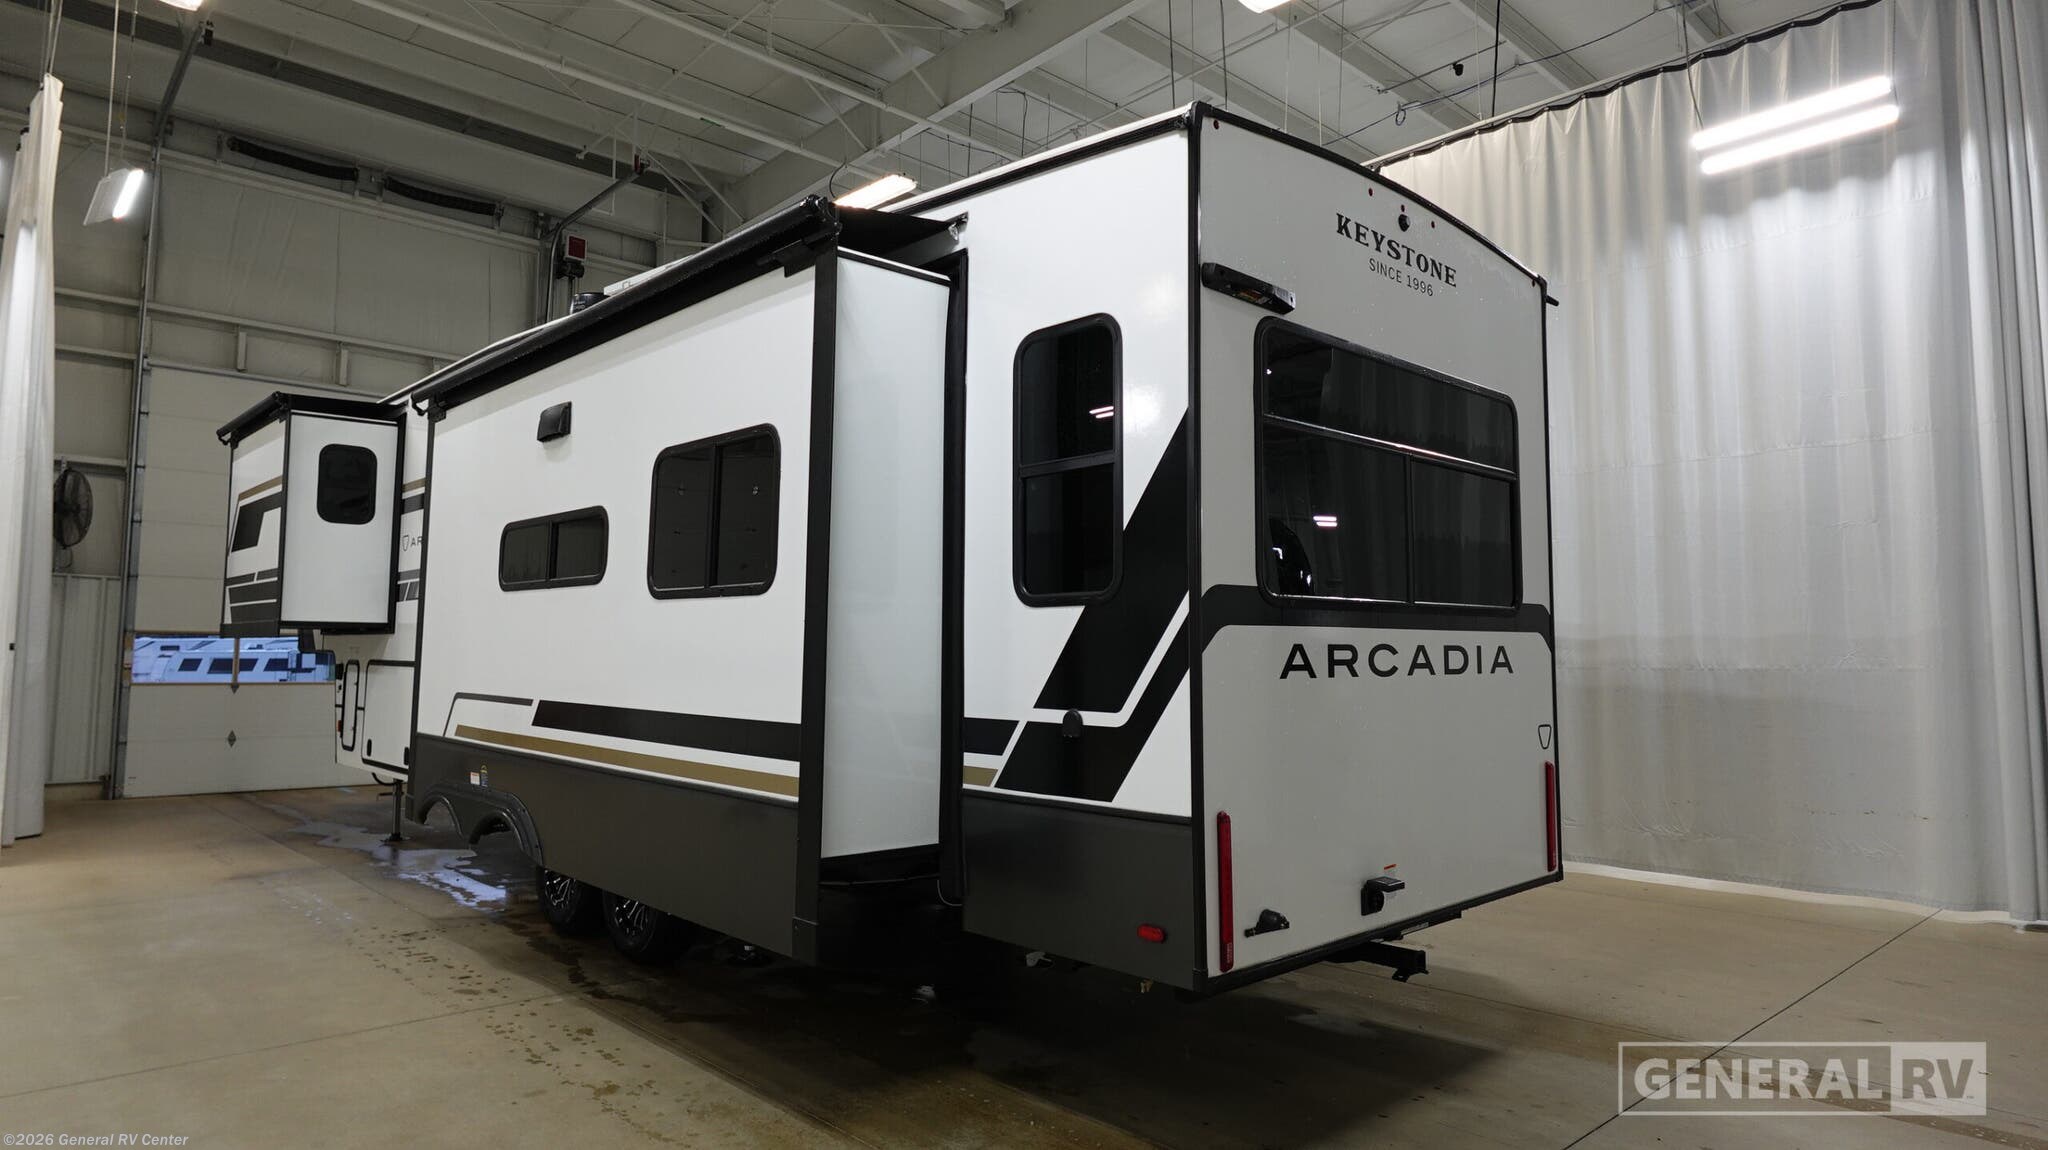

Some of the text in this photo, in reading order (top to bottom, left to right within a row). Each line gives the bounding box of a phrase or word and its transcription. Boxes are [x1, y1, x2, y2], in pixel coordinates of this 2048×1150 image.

[1336, 213, 1457, 287] KEYSTONE
[1369, 257, 1434, 297] SINCE 1996
[1279, 643, 1514, 679] ARCADIA
